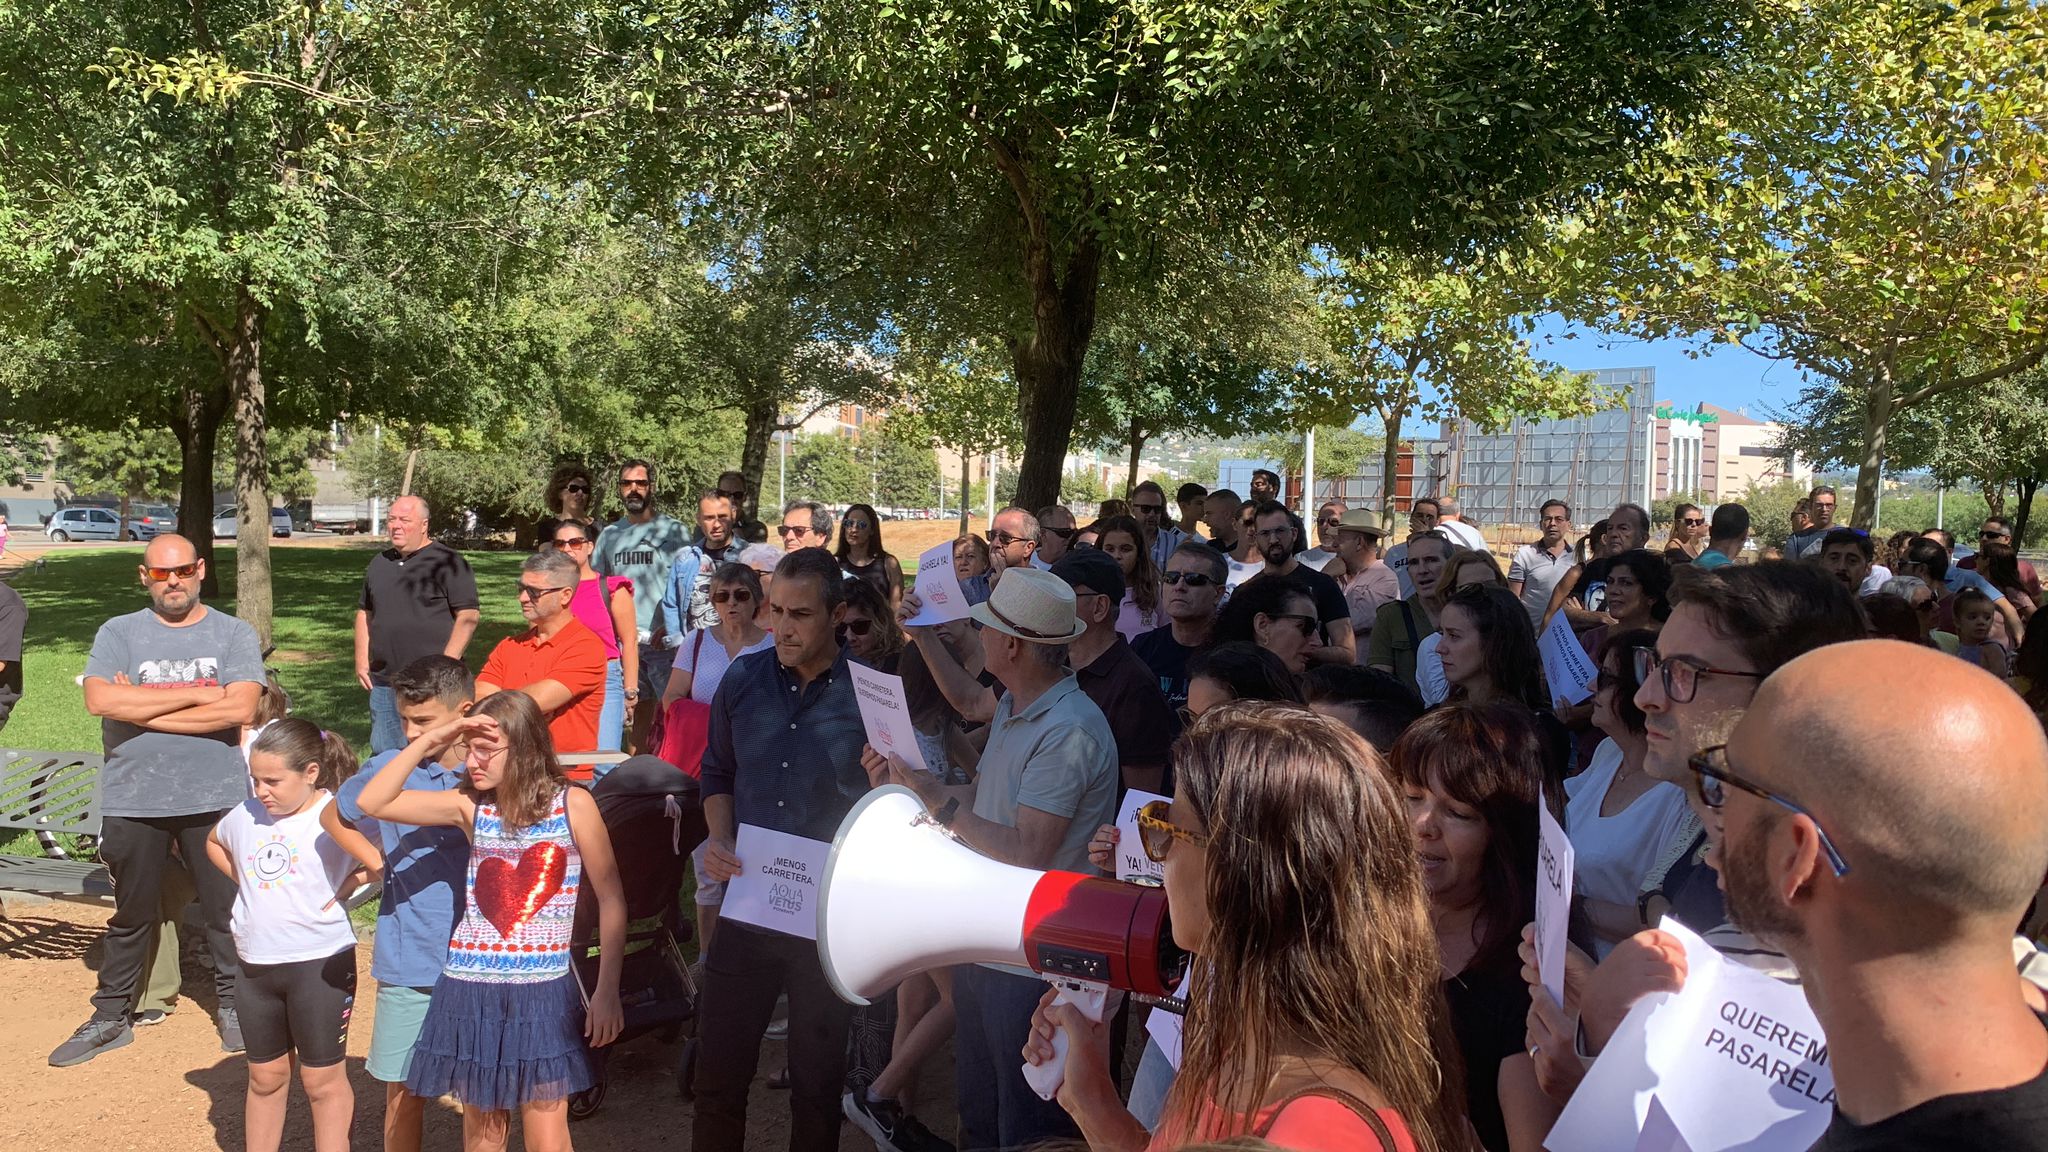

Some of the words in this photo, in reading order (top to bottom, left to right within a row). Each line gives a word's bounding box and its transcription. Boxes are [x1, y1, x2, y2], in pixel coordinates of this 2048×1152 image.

[614, 551, 654, 566] PUMA
[773, 857, 807, 872] ¡MENOS
[1125, 854, 1142, 872] YA!
[762, 865, 815, 887] CARRETERA,
[768, 894, 803, 912] VETUS
[1720, 1001, 1829, 1067] QUEREM
[1704, 1028, 1838, 1106] PASARELA
